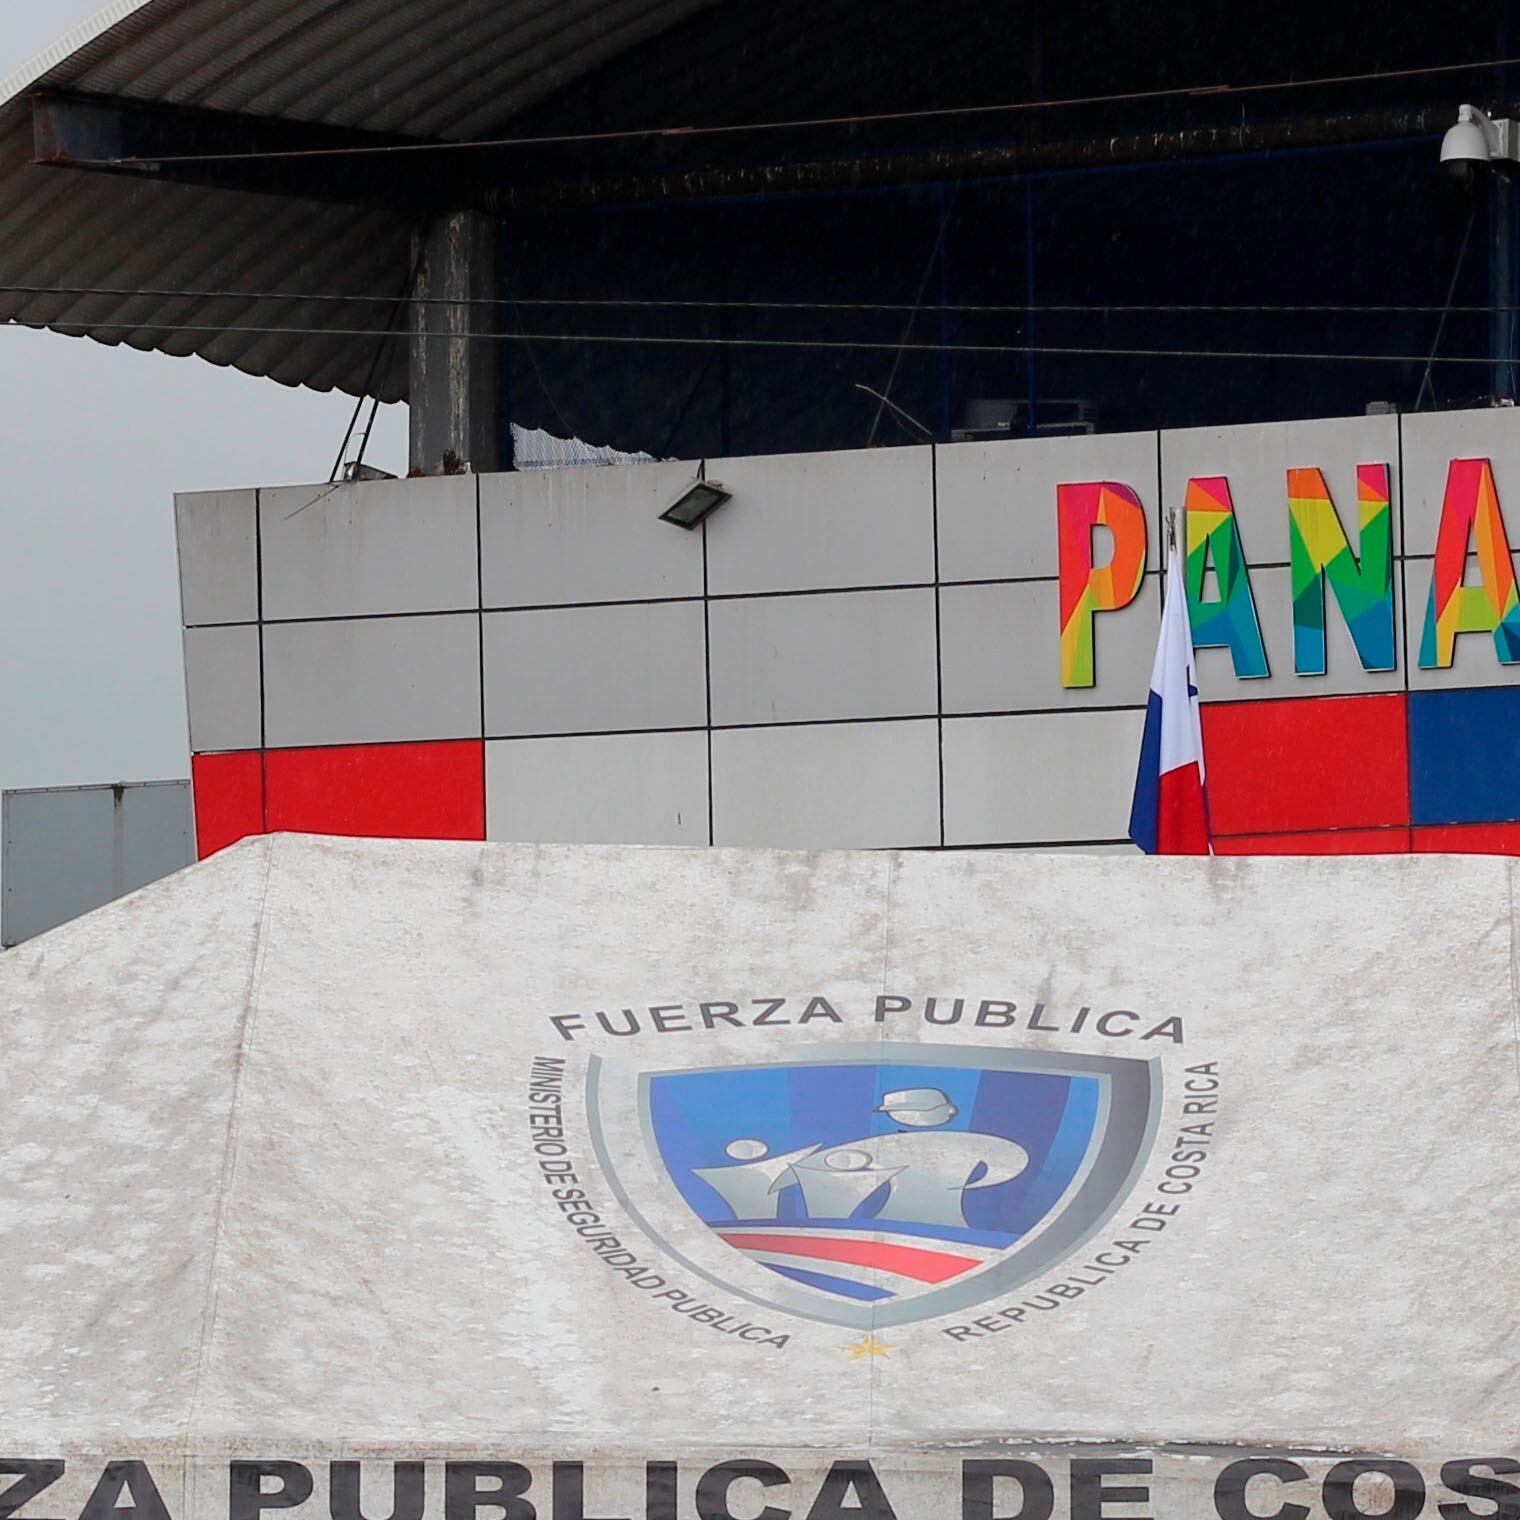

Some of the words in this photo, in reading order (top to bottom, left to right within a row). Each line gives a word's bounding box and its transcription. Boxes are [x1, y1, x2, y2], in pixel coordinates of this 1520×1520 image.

[548, 996, 844, 1042] FUERZA
[874, 994, 1186, 1044] PUBLICA
[528, 1055, 568, 1156] MINISTERIO
[1183, 1060, 1220, 1114] RICA
[538, 1159, 579, 1185] DE
[1156, 1121, 1216, 1195] COSTA
[551, 1187, 666, 1290] SEGURIDAD
[1129, 1201, 1182, 1233] DE
[651, 1288, 792, 1350] PUBLICA
[941, 1239, 1151, 1342] REPUBLICA
